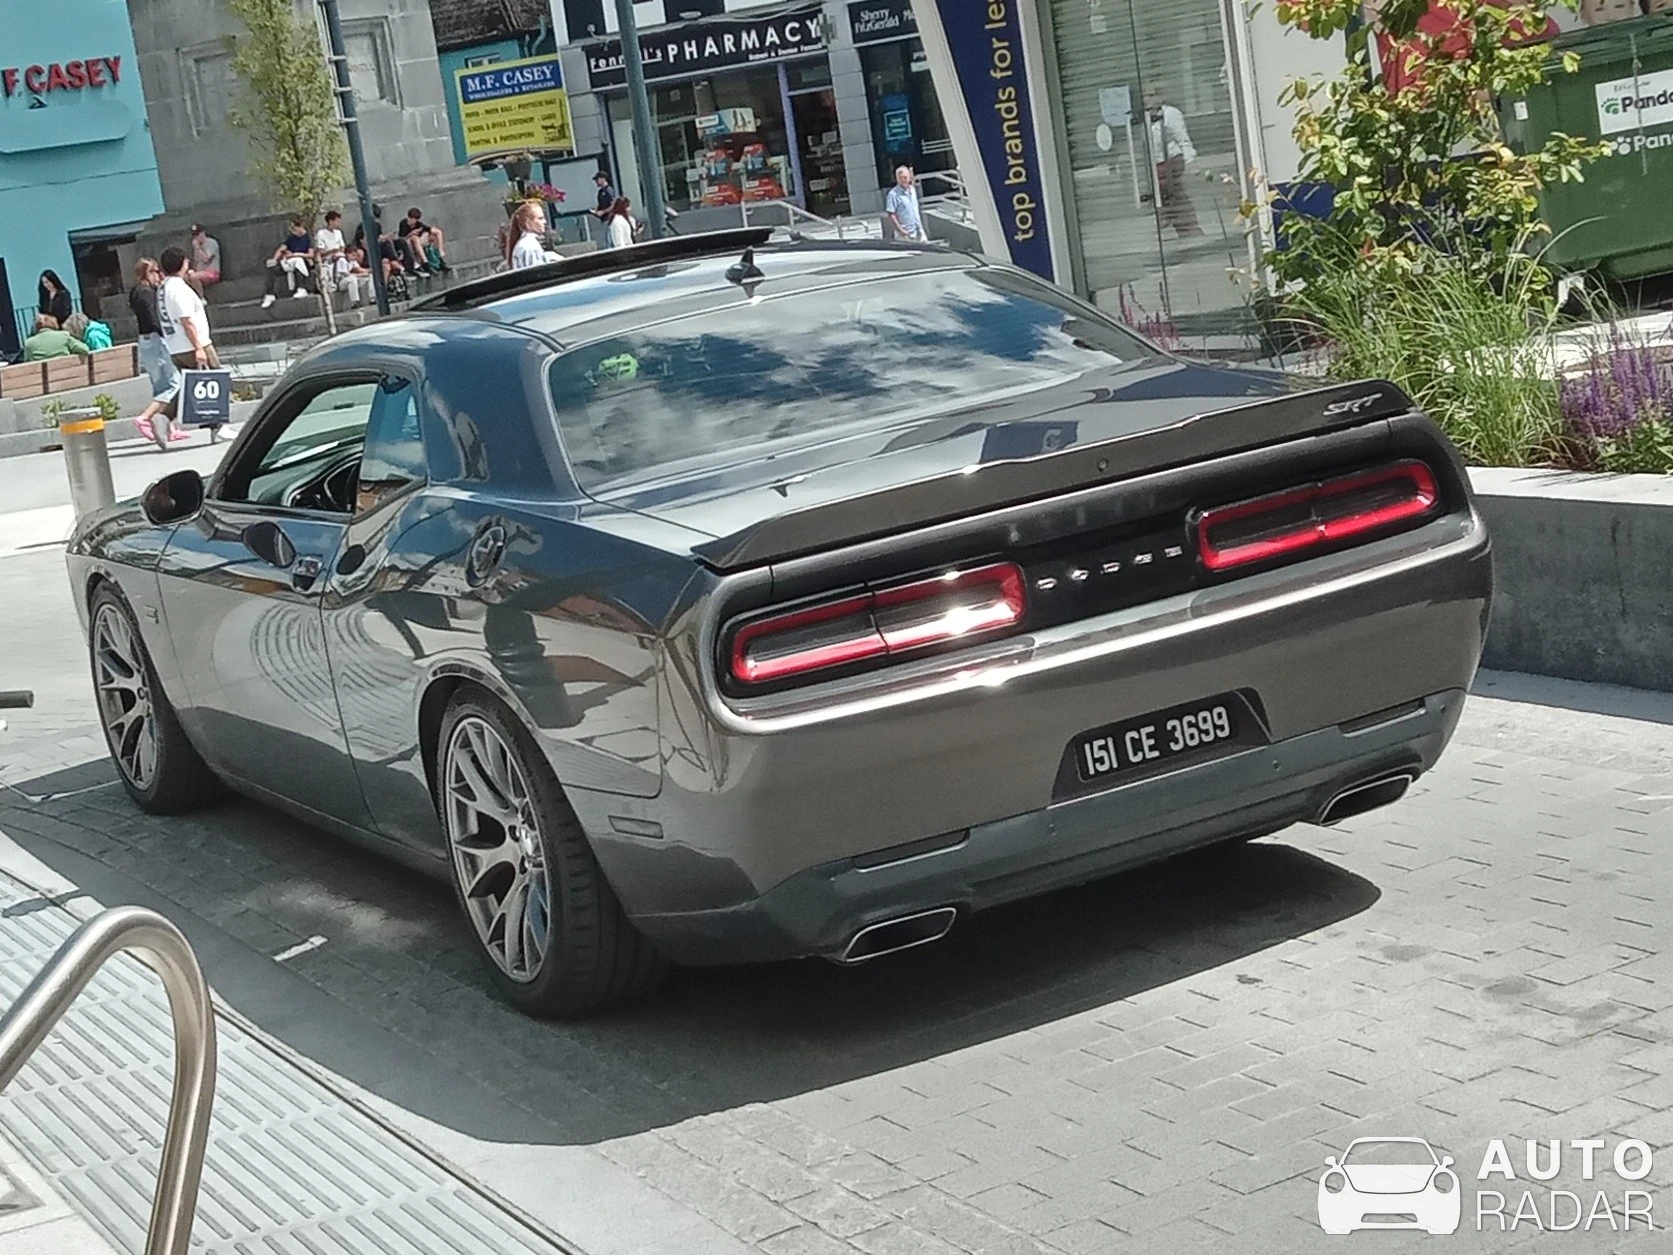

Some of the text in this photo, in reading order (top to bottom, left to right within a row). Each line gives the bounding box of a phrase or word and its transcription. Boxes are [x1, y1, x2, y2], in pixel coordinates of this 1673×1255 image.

[667, 18, 818, 63] PHARMACY
[25, 56, 121, 94] CASEY
[467, 65, 554, 92] M.F. CASEY
[984, 0, 1036, 242] top brands for le
[1633, 134, 1673, 152] Pan
[194, 380, 220, 399] 60
[1323, 393, 1382, 415] SRT
[1036, 545, 1183, 590] DODGE
[1084, 706, 1231, 775] 151 CE 3699
